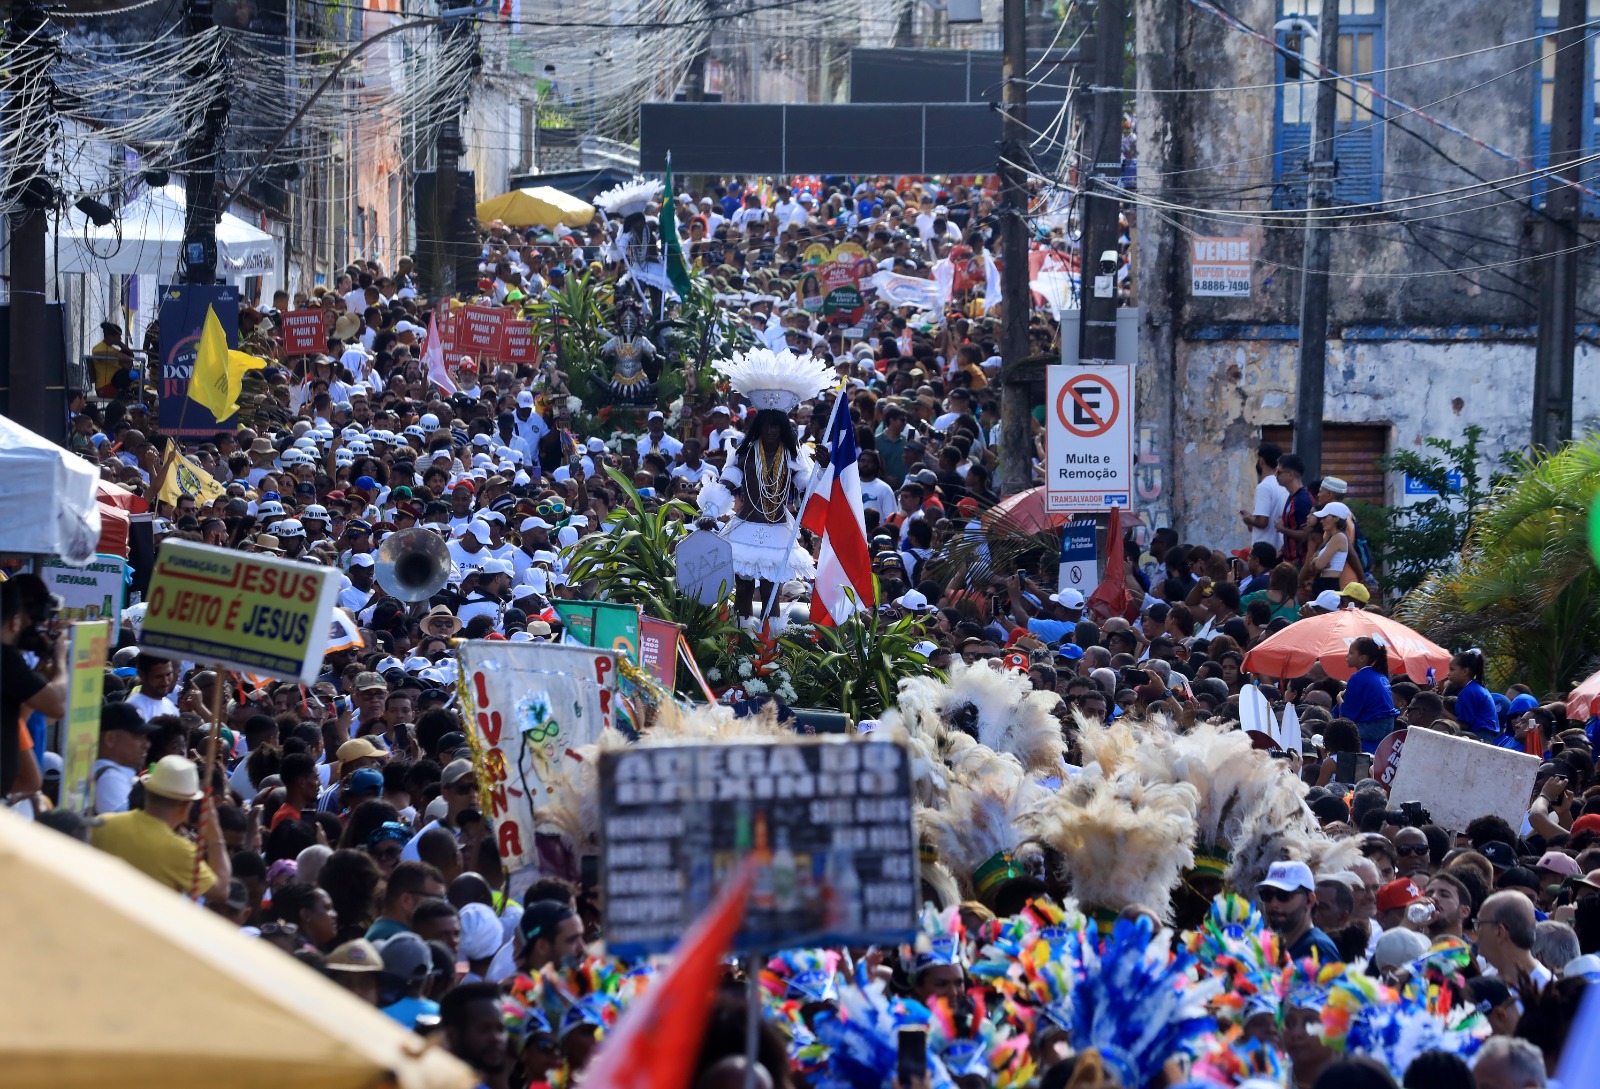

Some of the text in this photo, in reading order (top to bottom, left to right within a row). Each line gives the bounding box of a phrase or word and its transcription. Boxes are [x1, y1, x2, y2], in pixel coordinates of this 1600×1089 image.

[1194, 241, 1249, 261] VENDE
[1194, 280, 1249, 291] 9.8886-7490
[286, 315, 321, 325] PREFEITURA,
[466, 311, 502, 324] PREFEITURA,
[292, 327, 310, 337] PAGUE
[471, 323, 489, 333] PAGUE
[508, 337, 526, 346] PAGUE
[163, 378, 191, 399] JU
[1073, 387, 1103, 425] E
[1066, 453, 1110, 464] Multa e
[1059, 468, 1118, 481] Remoção
[1050, 495, 1103, 503] TRANSALVADOR
[56, 574, 98, 587] DEVASSA
[229, 561, 319, 603] JESUS
[150, 585, 310, 646] O JEITO É JESUS
